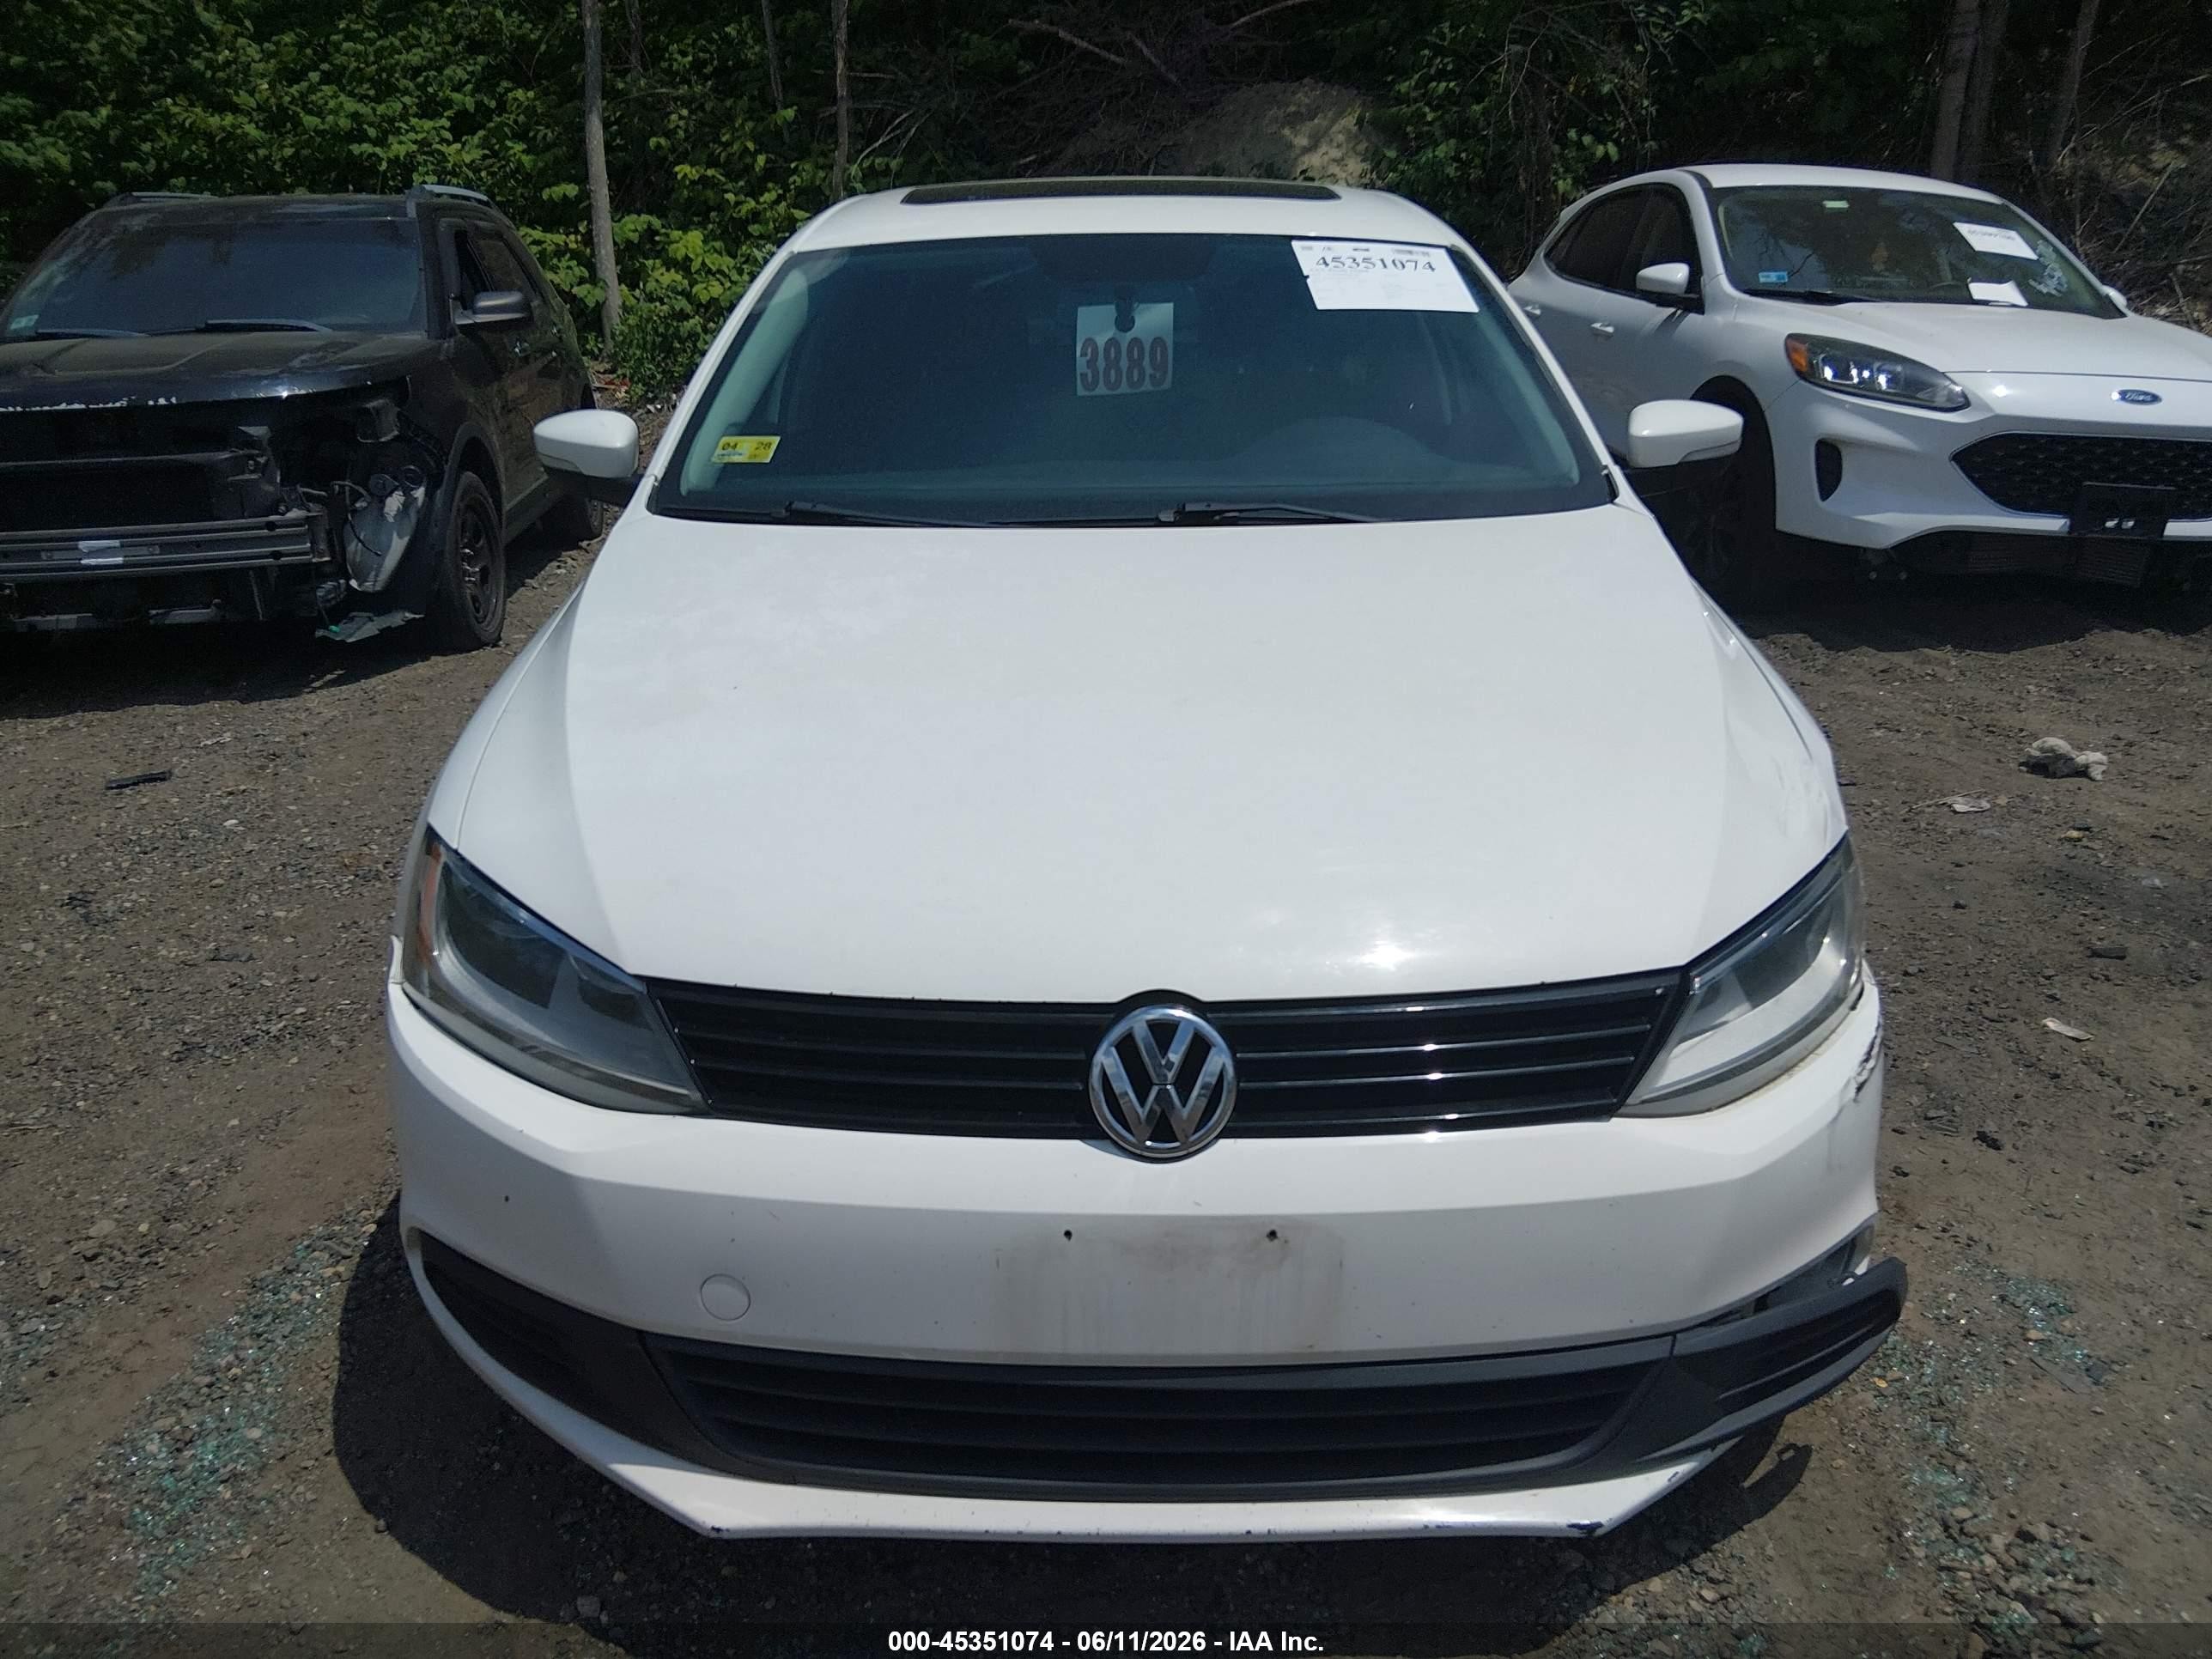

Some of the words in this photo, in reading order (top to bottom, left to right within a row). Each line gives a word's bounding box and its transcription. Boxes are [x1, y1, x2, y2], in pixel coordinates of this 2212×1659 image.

[1316, 255, 1437, 273] 45351074
[1079, 336, 1169, 392] 3889
[721, 441, 738, 451] 04
[1090, 1012, 1230, 1152] VW
